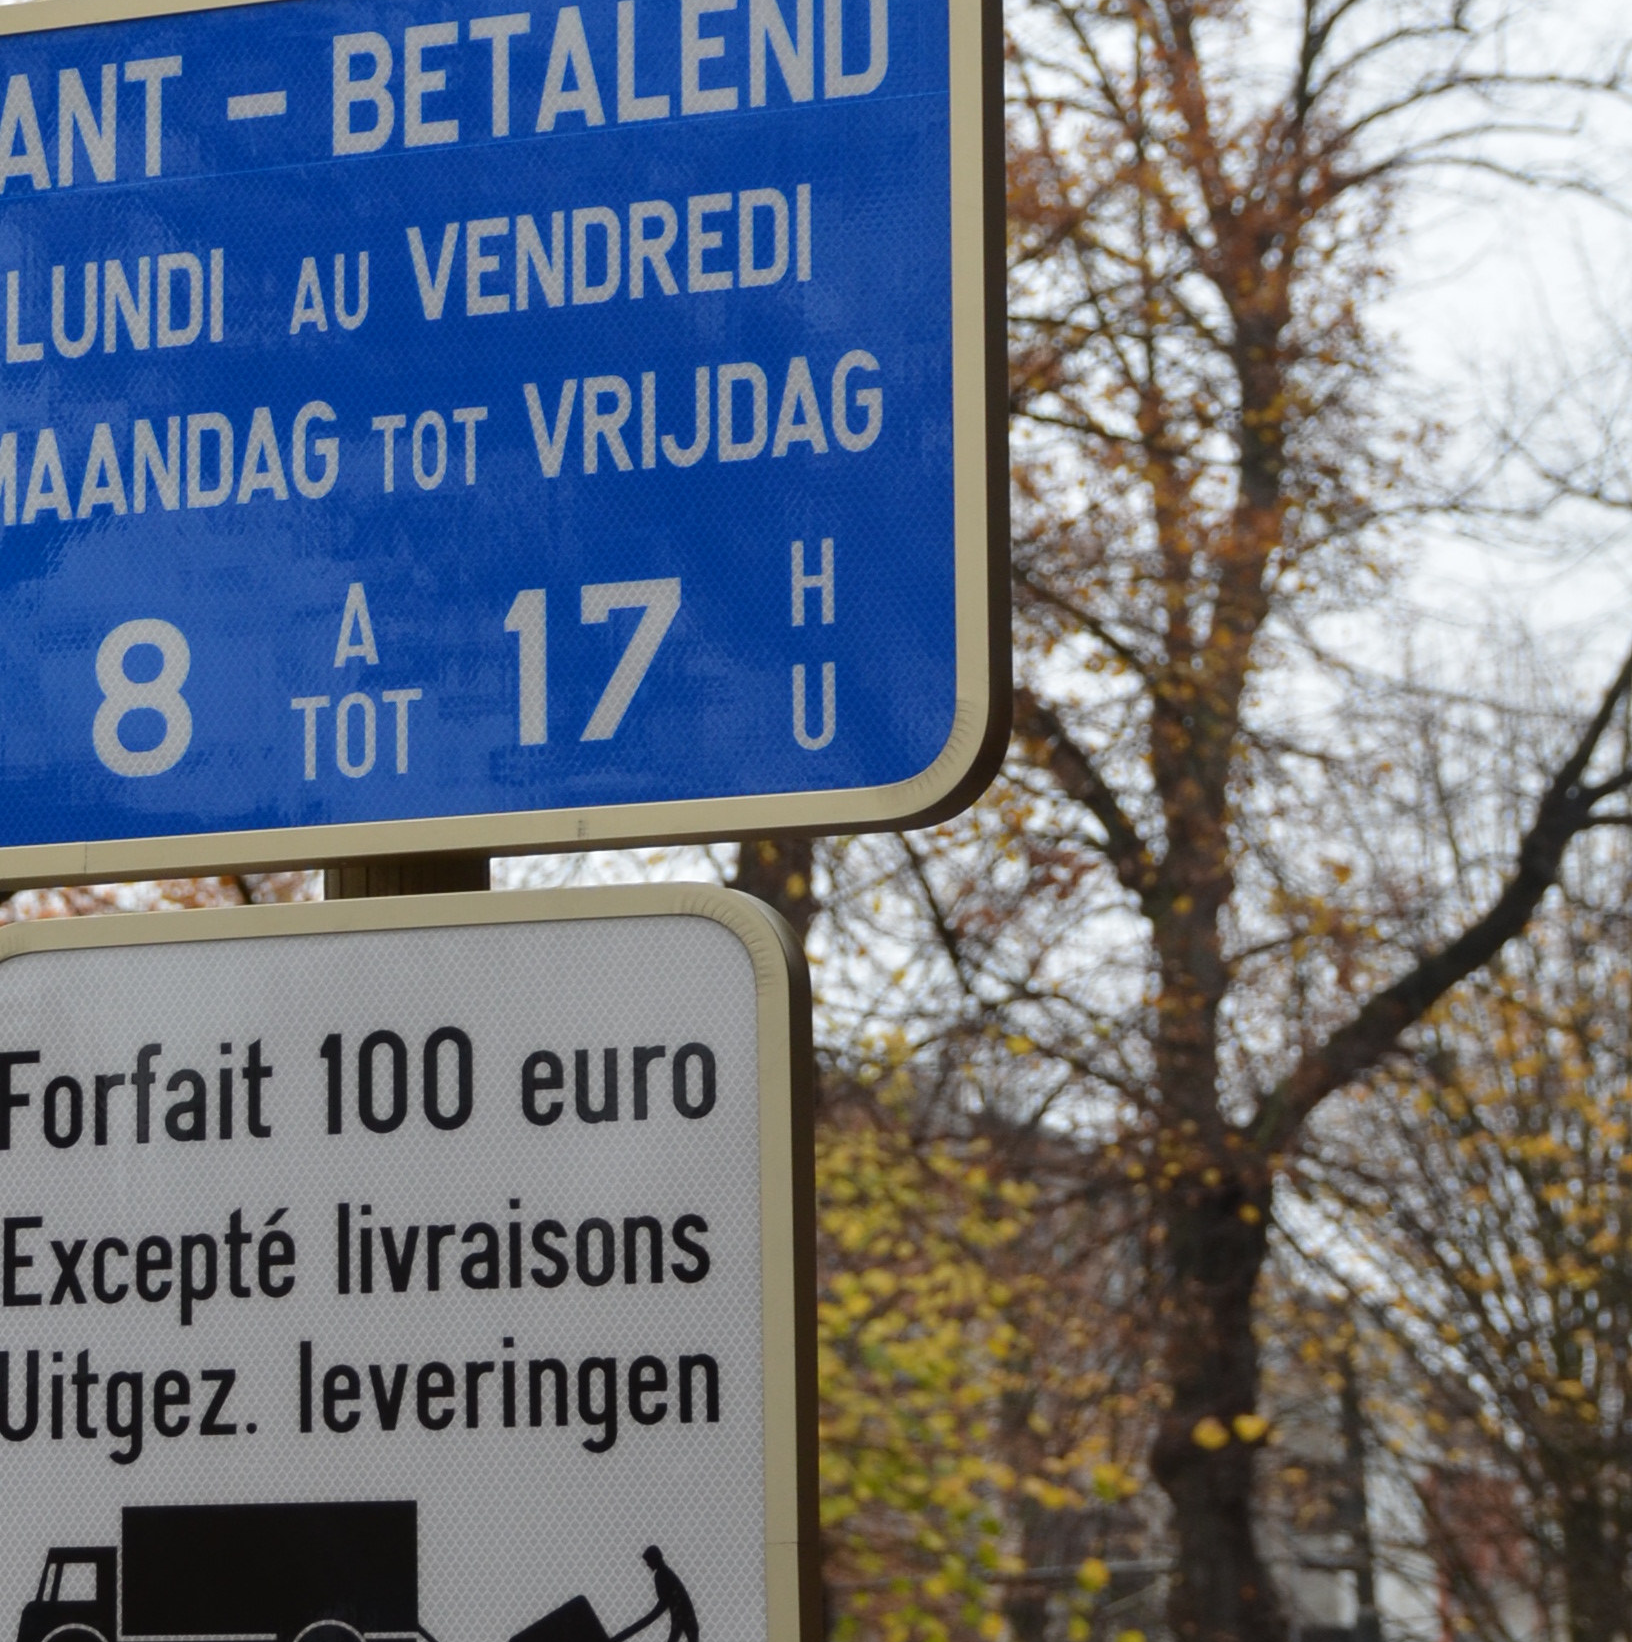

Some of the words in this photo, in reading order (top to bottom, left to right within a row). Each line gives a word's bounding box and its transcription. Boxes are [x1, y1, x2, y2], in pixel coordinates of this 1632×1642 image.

[6, 248, 225, 363] LUNDI
[290, 251, 369, 334] AU
[407, 183, 812, 320] VENDREDI
[372, 407, 488, 492] TOT
[524, 349, 883, 478] VRIJDAG
[92, 618, 193, 777] 8
[334, 582, 378, 668] A
[504, 577, 682, 746] 17
[791, 538, 835, 626] H
[291, 688, 422, 781] TOT
[792, 662, 837, 750] U
[320, 1026, 473, 1135] 100
[521, 1042, 717, 1127] euro
[2, 1207, 296, 1327] Excepté
[337, 1198, 711, 1295] livraisons
[299, 1336, 721, 1454] leveringen
